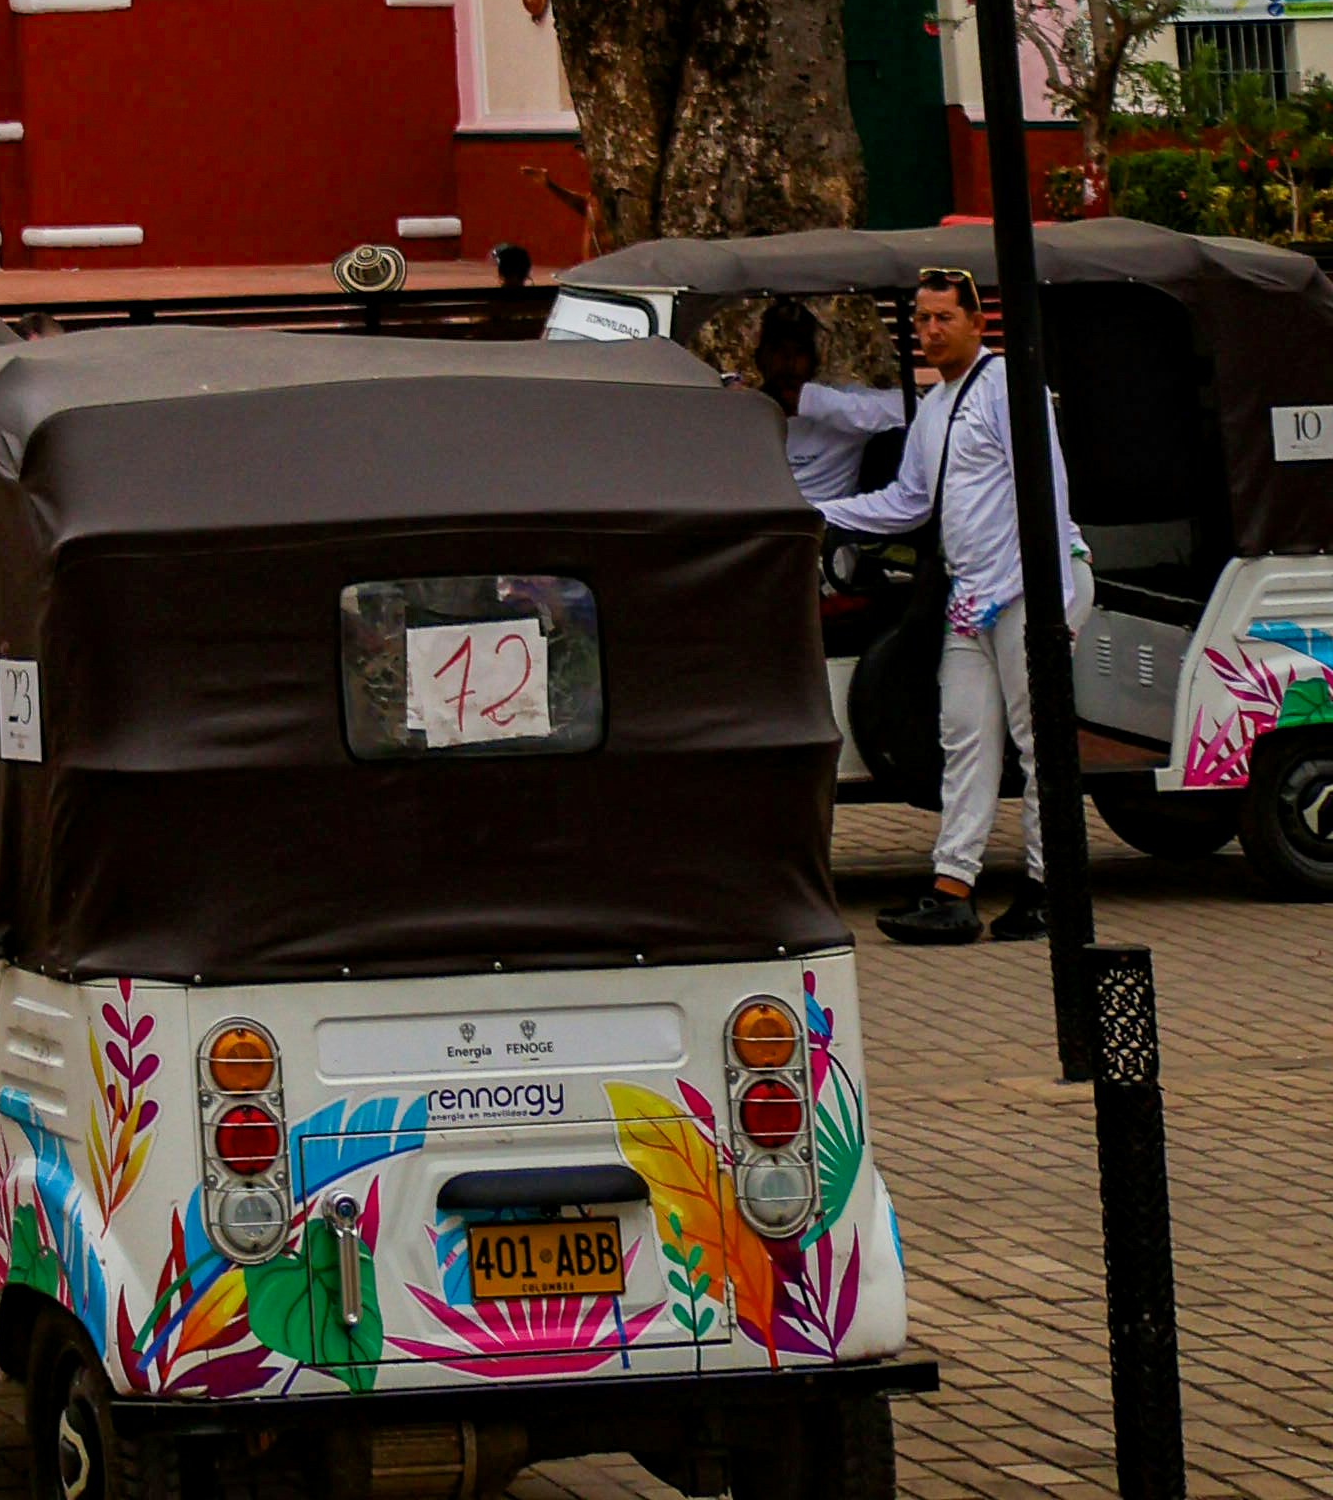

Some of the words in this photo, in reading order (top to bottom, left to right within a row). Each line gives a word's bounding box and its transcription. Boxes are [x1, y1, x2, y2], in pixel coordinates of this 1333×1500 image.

[1294, 411, 1321, 440] 10
[6, 669, 32, 725] 23
[506, 1041, 554, 1055] FENOGE
[428, 1083, 564, 1117] rennorgy
[476, 1236, 537, 1280] 401
[556, 1232, 618, 1277] ABB
